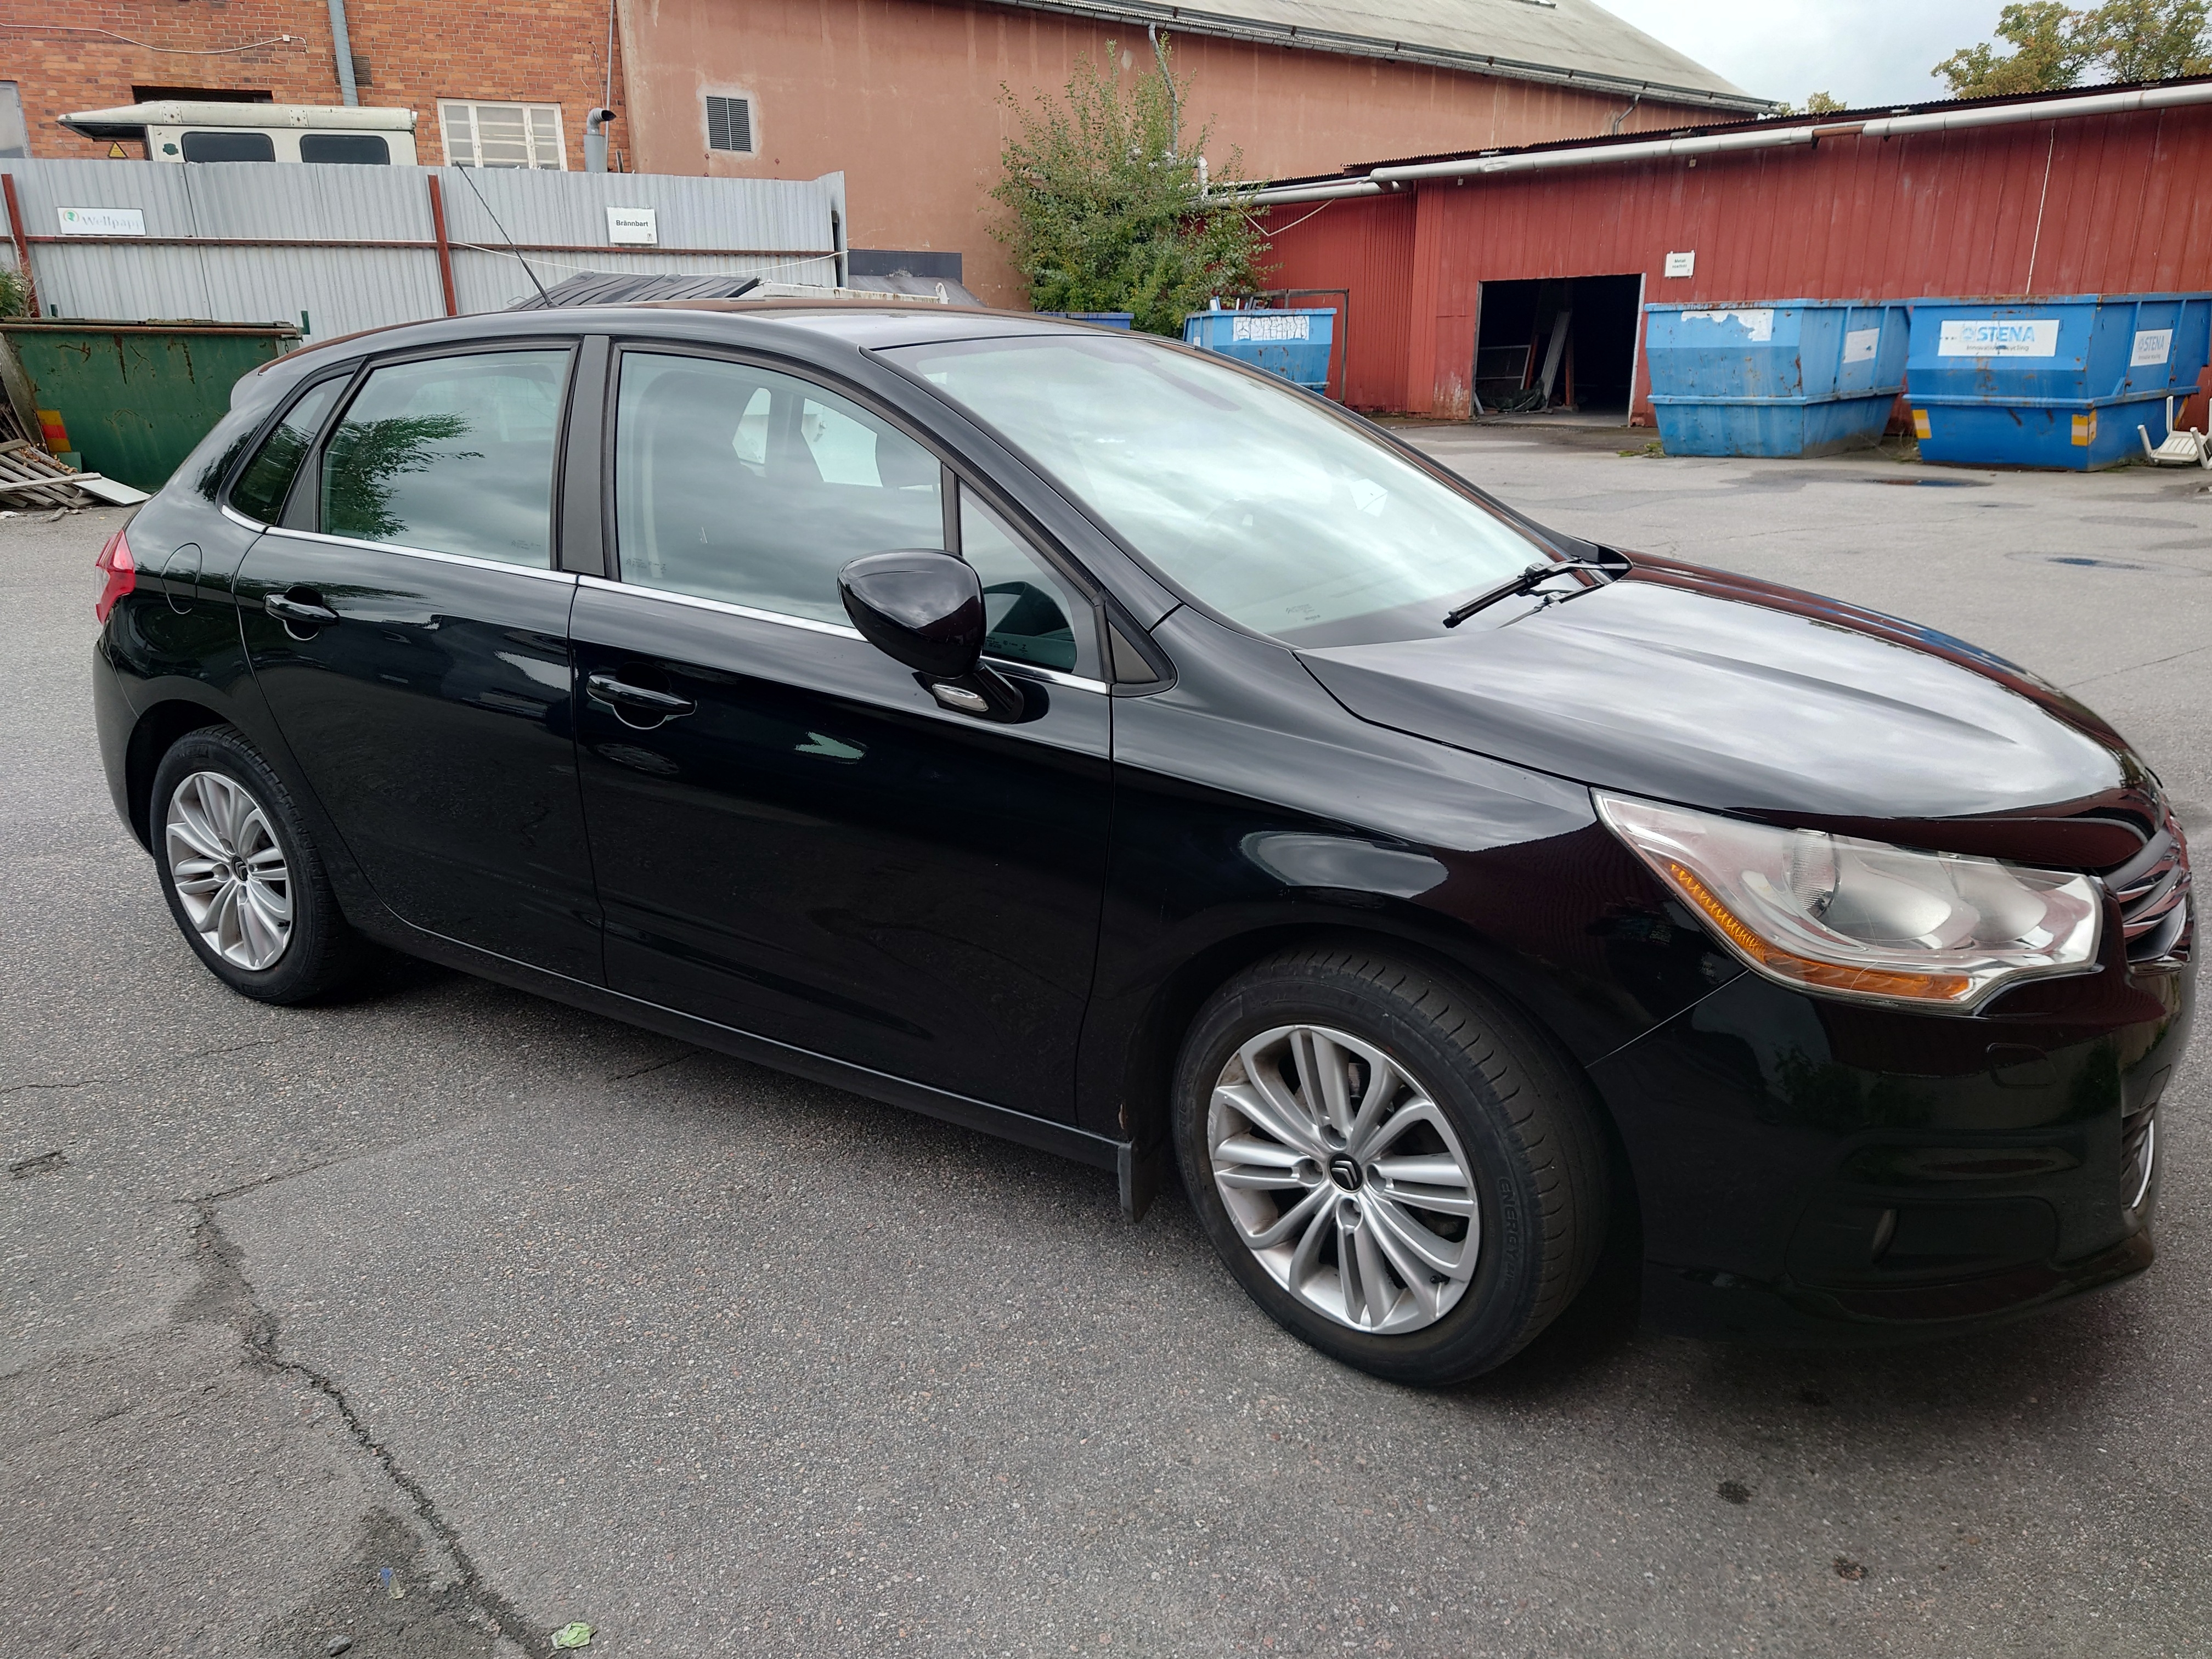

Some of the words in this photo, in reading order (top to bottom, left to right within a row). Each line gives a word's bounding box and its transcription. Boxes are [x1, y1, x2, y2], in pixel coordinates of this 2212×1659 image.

[1977, 326, 2035, 342] STENA
[2143, 335, 2164, 351] STENA
[1498, 1177, 1519, 1261] ENERGY
